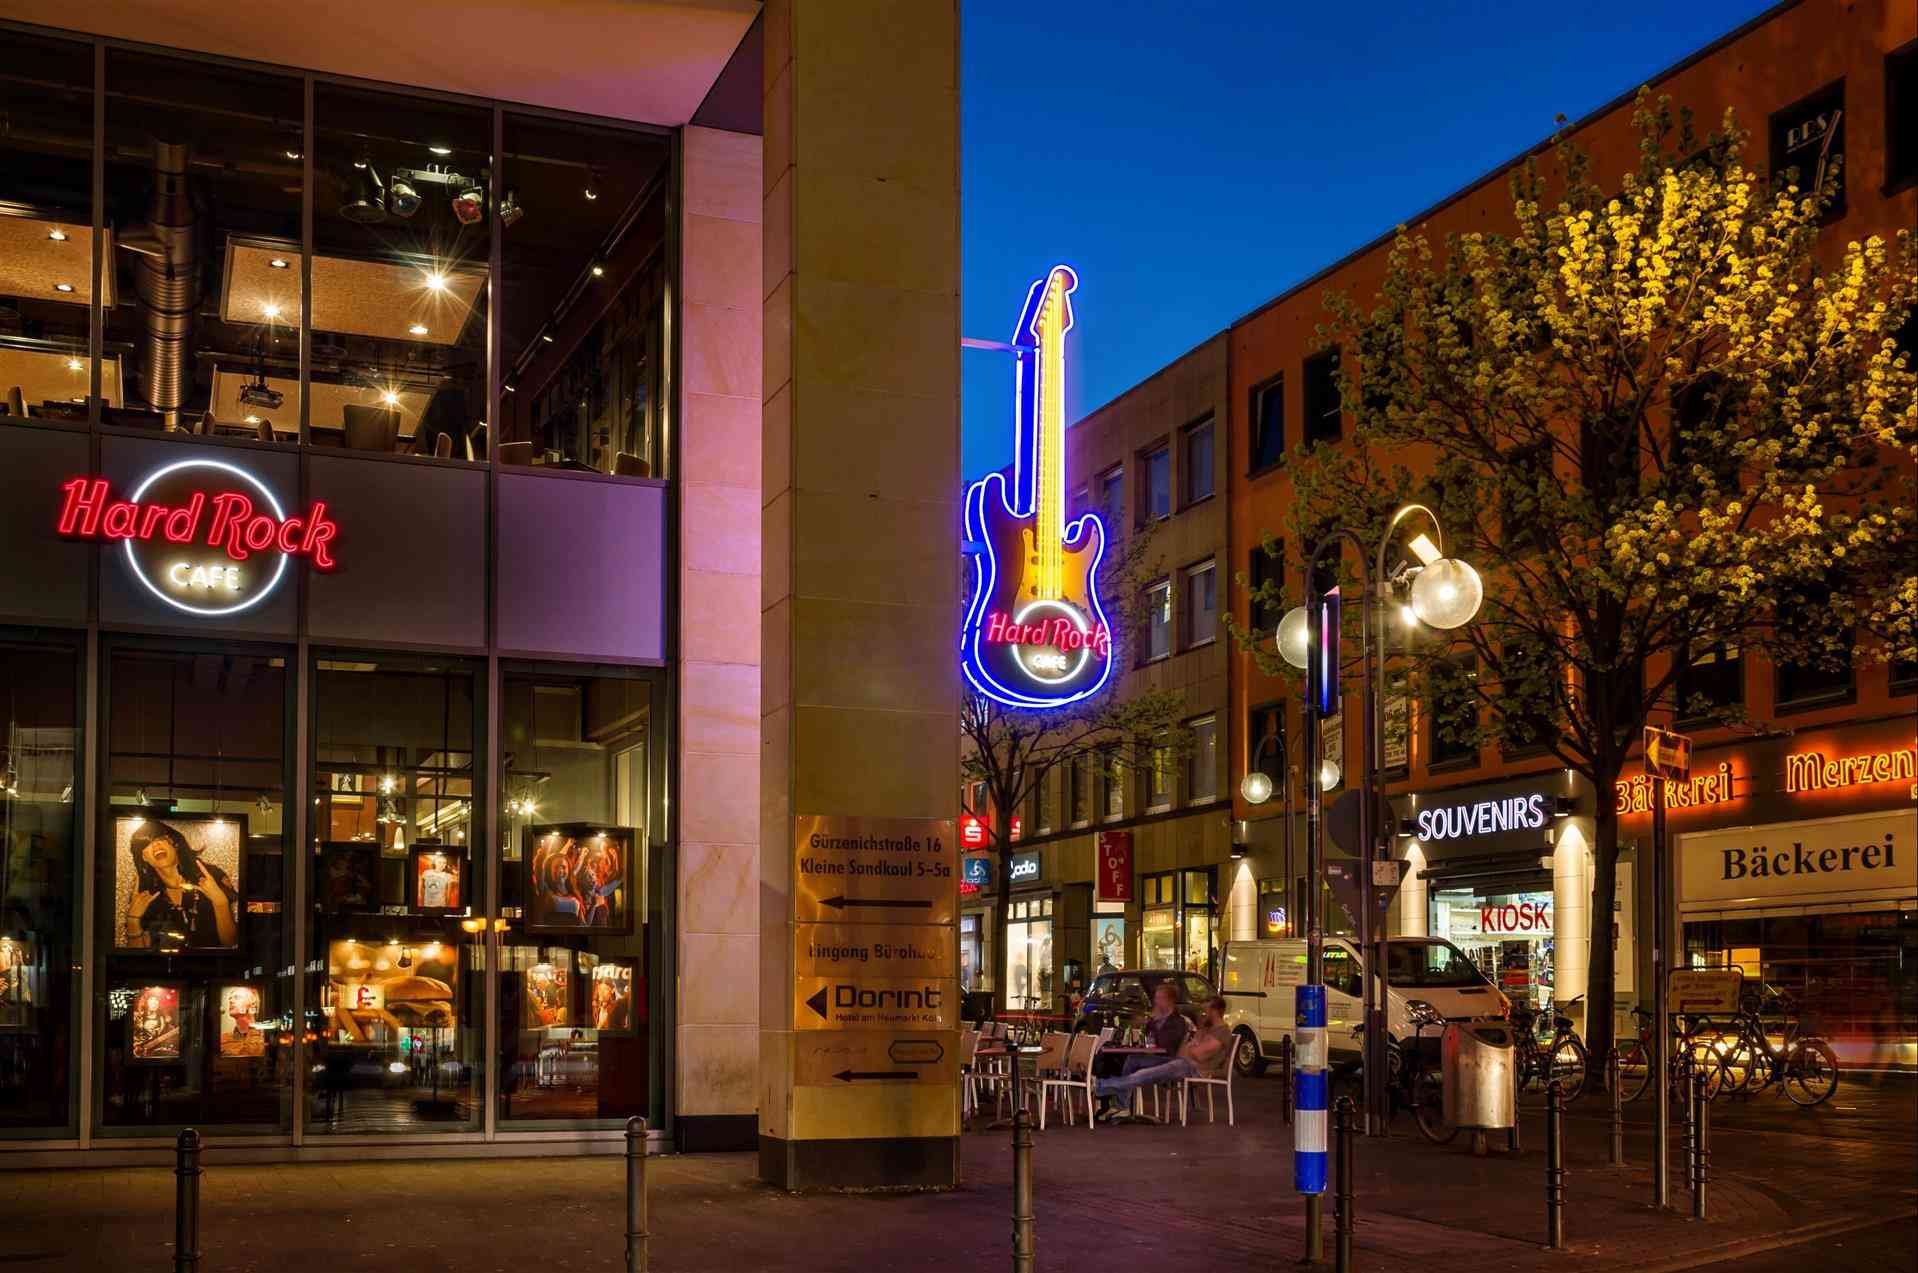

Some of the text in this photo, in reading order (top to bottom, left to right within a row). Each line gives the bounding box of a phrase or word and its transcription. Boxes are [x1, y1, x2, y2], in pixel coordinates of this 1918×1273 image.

[58, 478, 337, 568] Hard Rock
[168, 562, 241, 590] CAFE
[987, 612, 1108, 657] Hard Rock
[1418, 794, 1544, 841] SOUVENIRS
[810, 834, 942, 853] Gürzenichstraße 16
[1720, 832, 1897, 881] Bäckerei
[800, 858, 845, 874] Kleine
[849, 859, 913, 877] Sandkaul
[1481, 902, 1550, 932] KIOSK
